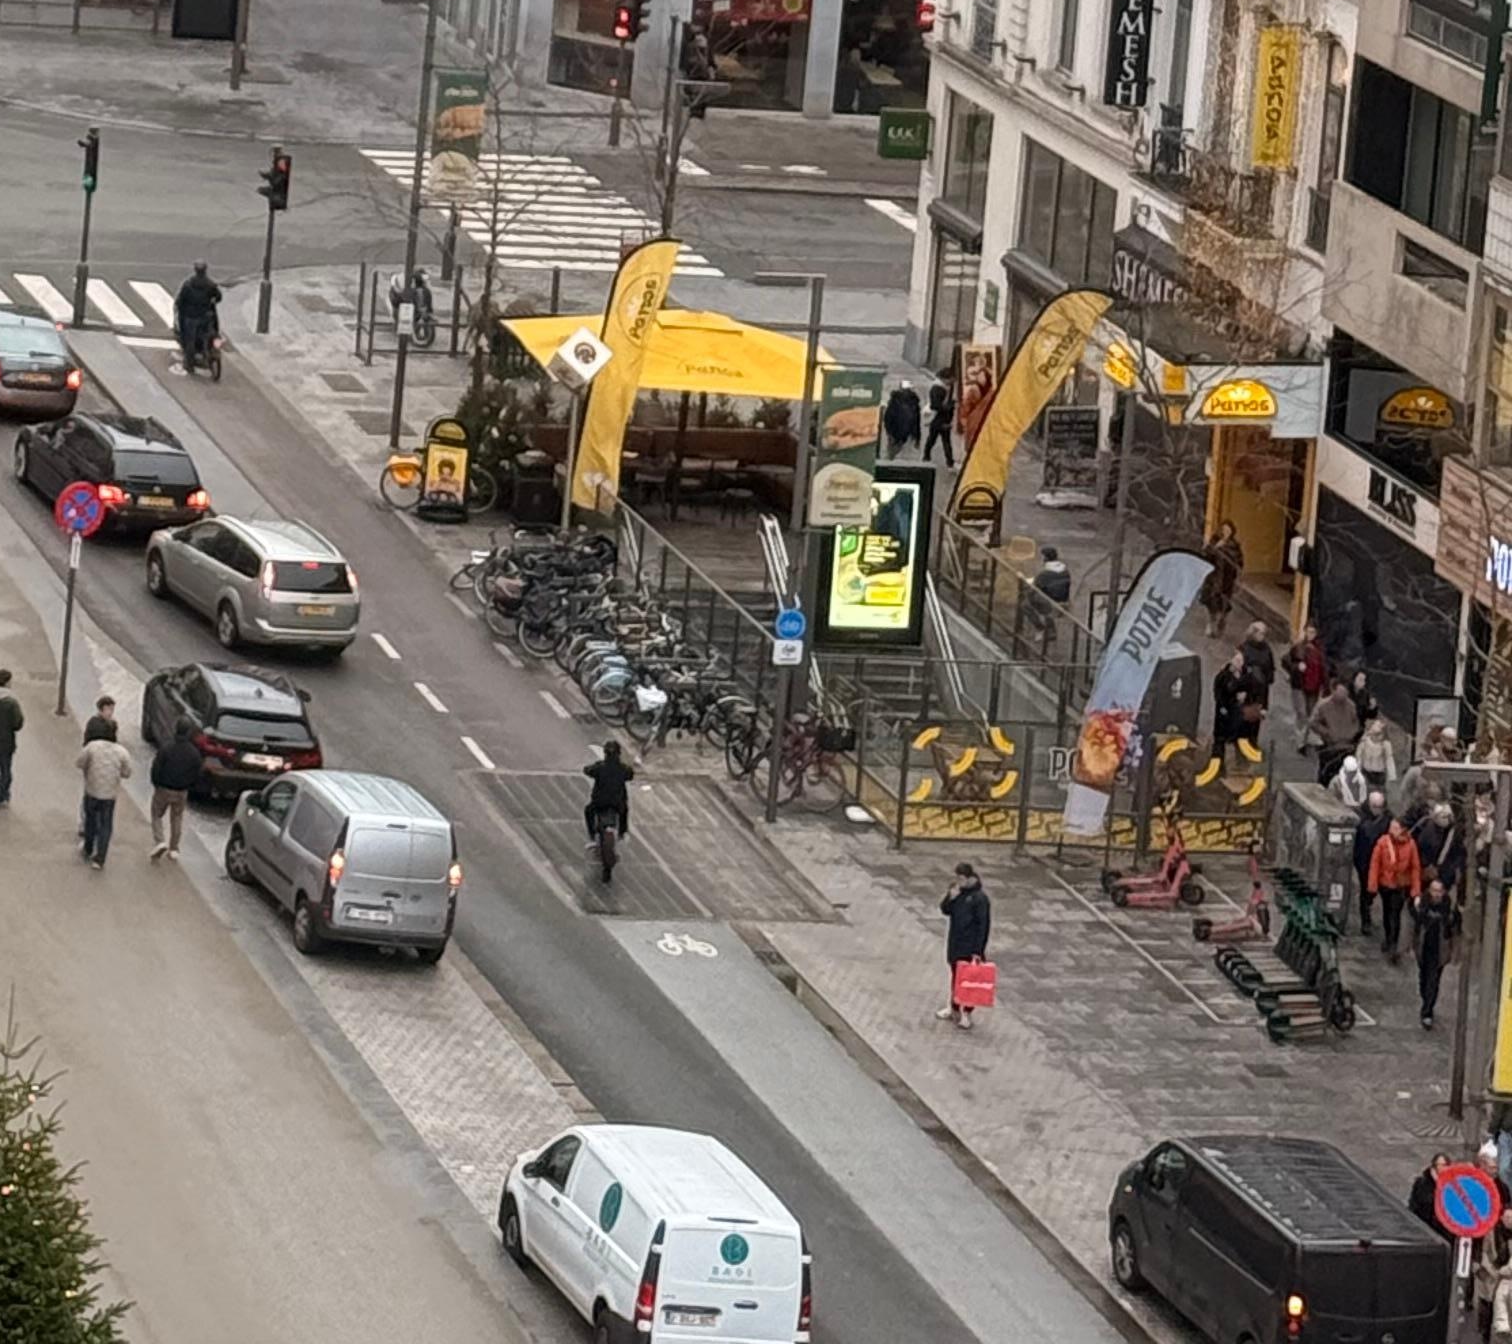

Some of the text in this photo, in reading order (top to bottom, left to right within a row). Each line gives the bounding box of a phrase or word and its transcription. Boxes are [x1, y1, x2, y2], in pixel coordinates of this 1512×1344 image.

[1037, 323, 1081, 379] Panos
[1210, 396, 1270, 413] Panos
[1120, 585, 1174, 665] POTAE
